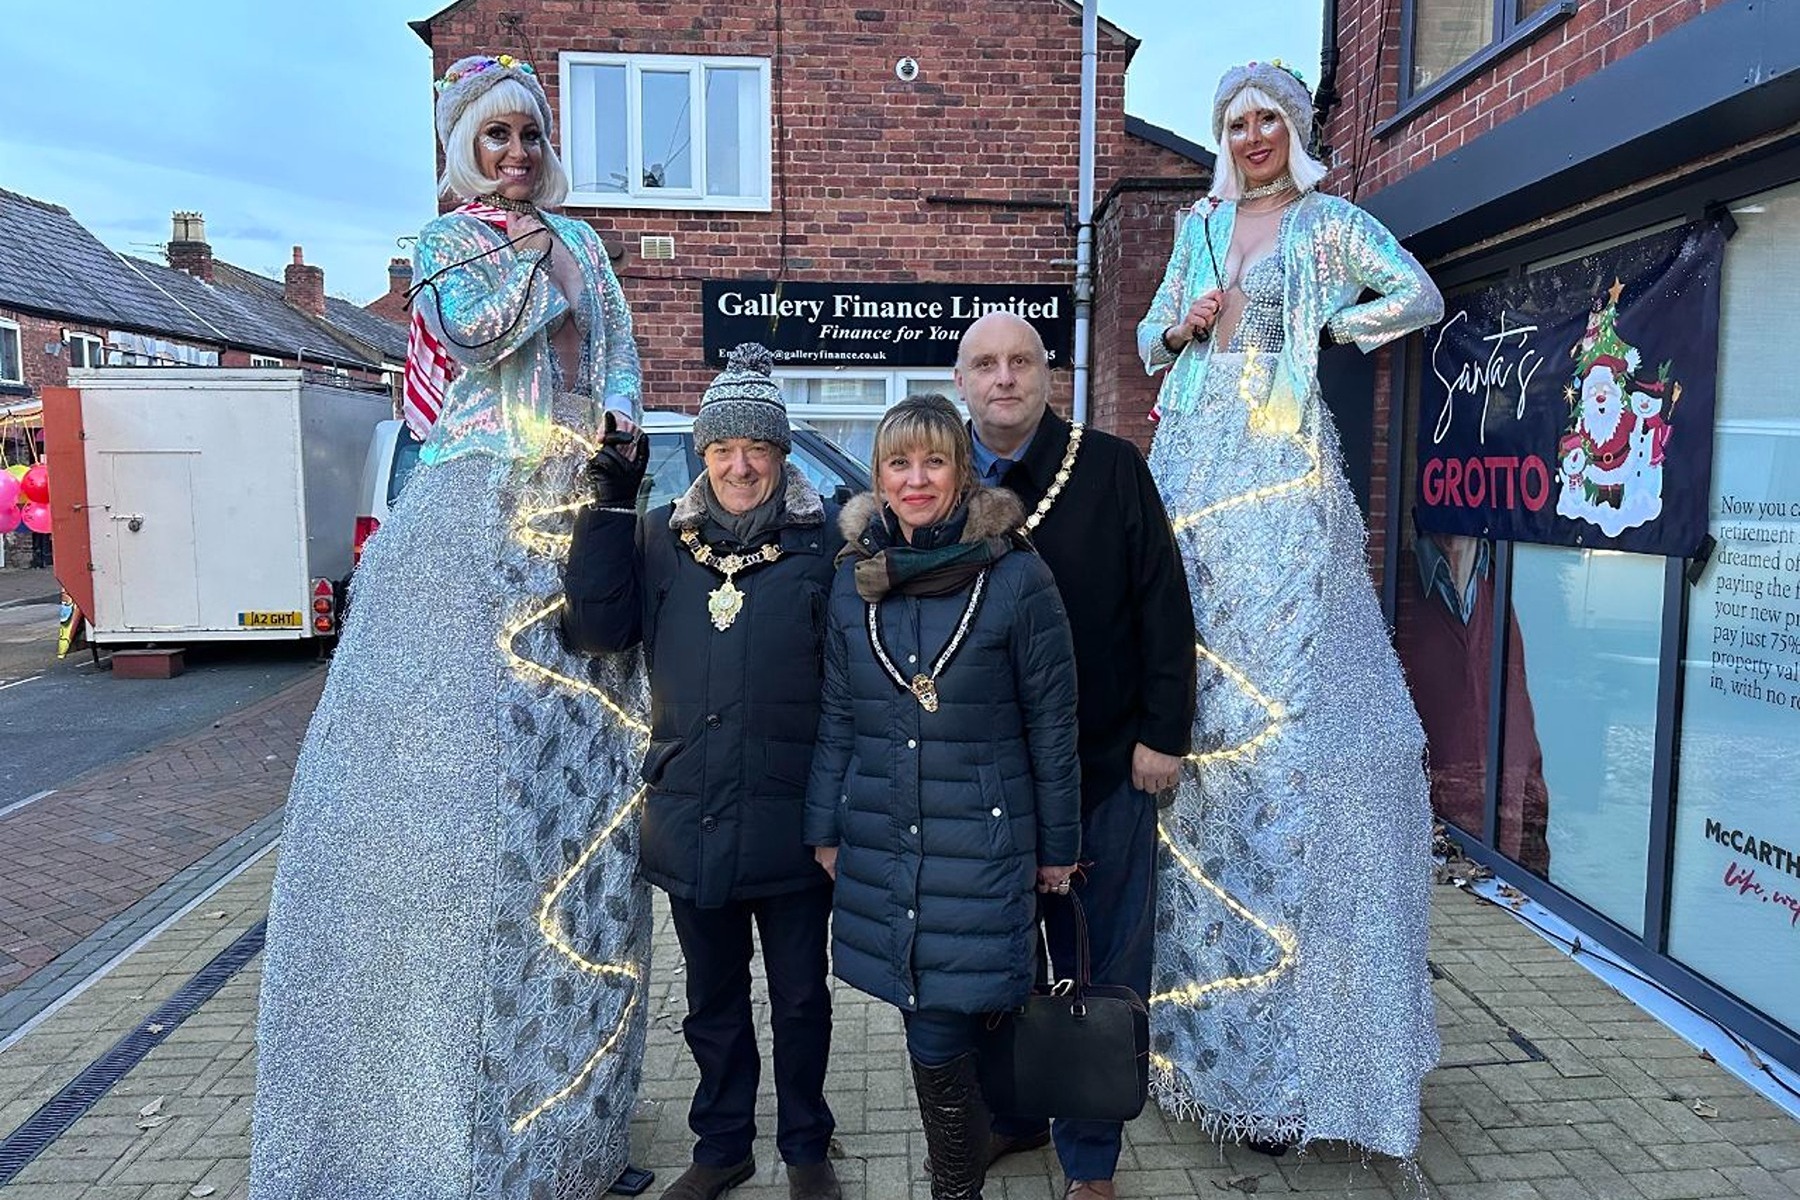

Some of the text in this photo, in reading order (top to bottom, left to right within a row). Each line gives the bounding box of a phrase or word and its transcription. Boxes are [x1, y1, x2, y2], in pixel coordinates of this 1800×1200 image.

[718, 292, 1059, 323] Gallery Finance Limited
[819, 324, 892, 340] Finance
[893, 325, 923, 344] for
[1433, 310, 1543, 445] Santa's
[1422, 454, 1549, 512] GROTTO
[1721, 496, 1755, 514] Now
[1758, 502, 1786, 520] you
[1720, 522, 1795, 543] retirement
[1717, 545, 1781, 570] dreamed
[1715, 574, 1763, 600] paying
[1767, 576, 1791, 598] the
[253, 613, 293, 624] A2 GHT
[1715, 601, 1747, 619] your
[1750, 606, 1782, 623] new
[1713, 625, 1800, 655] pay just 75%
[1711, 650, 1773, 680] property
[1709, 670, 1727, 695] in,
[1730, 678, 1762, 700] with
[1766, 689, 1787, 705] no
